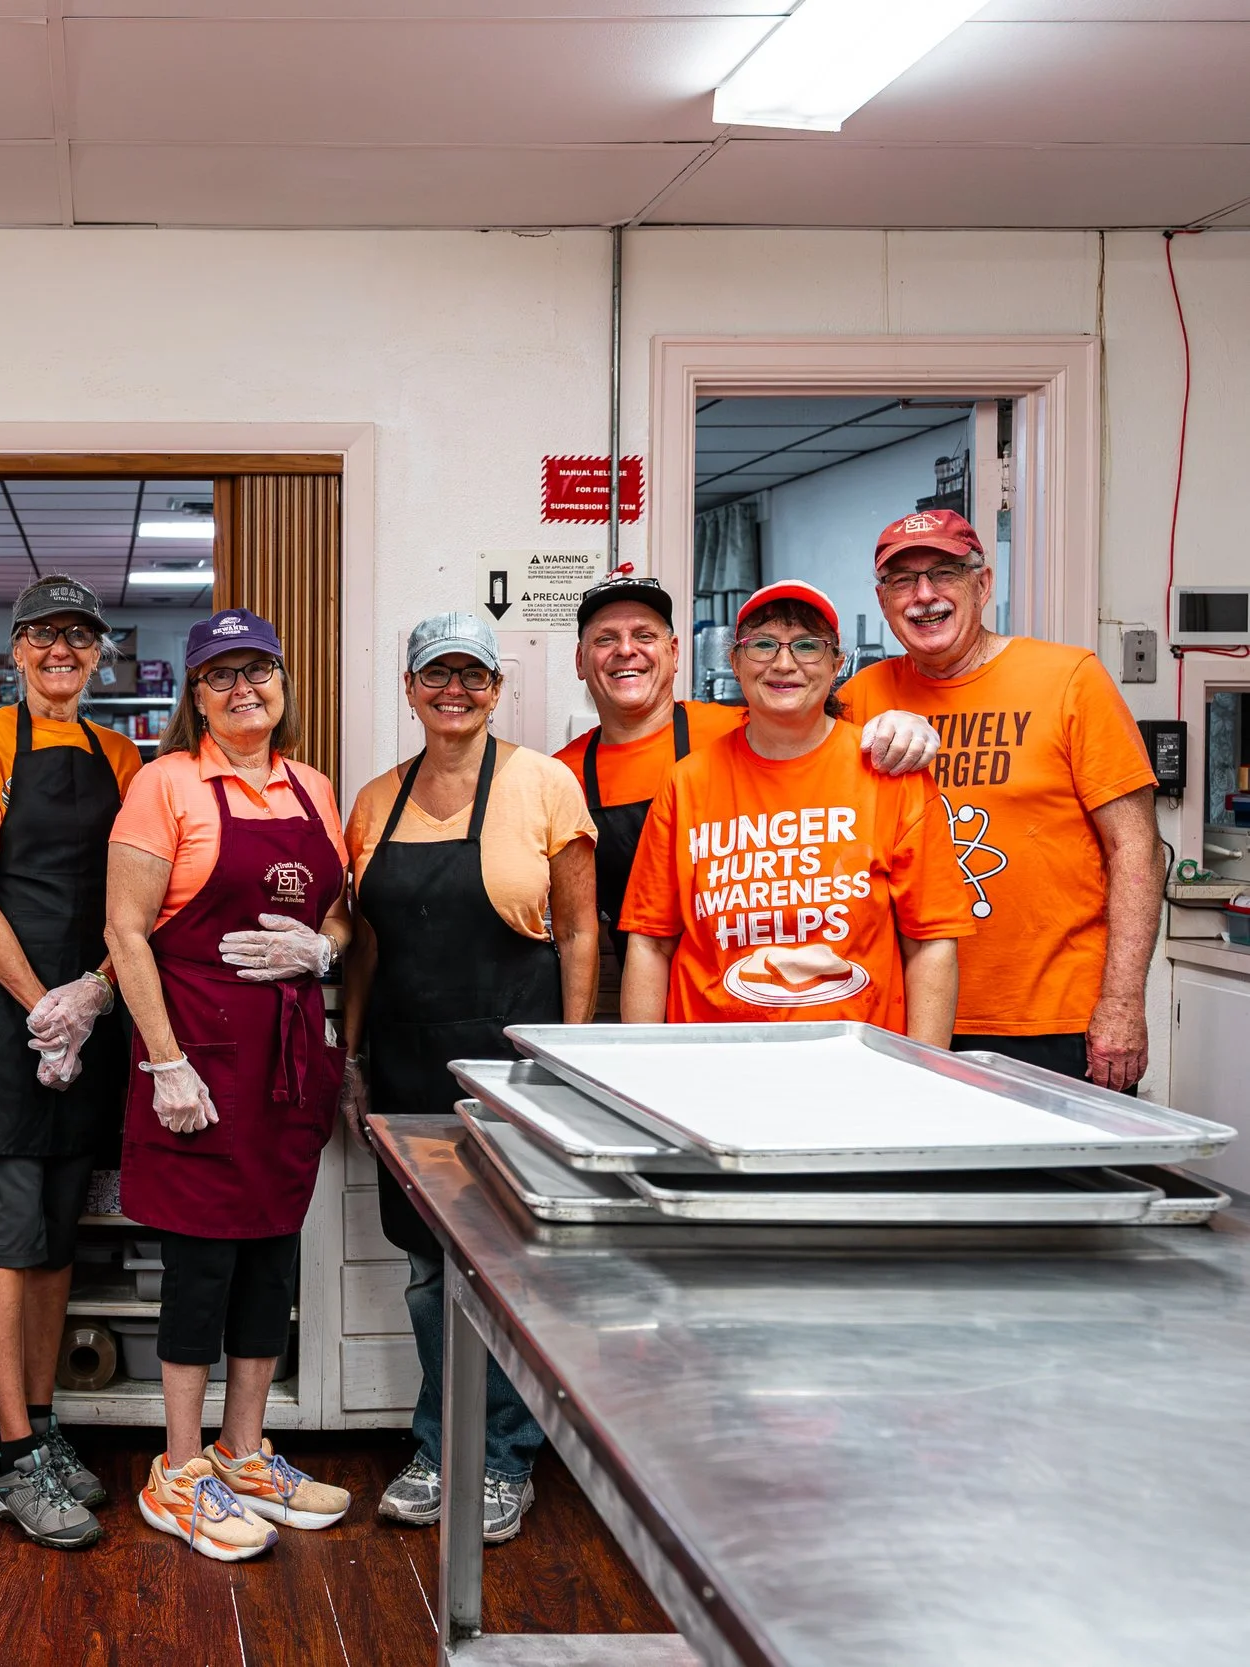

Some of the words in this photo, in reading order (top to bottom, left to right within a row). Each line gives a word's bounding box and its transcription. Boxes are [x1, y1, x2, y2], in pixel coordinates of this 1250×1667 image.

[593, 469, 627, 477] RELESE
[604, 503, 636, 511] STEM
[542, 555, 589, 563] WARNING
[533, 592, 582, 601] PRECAUCI
[927, 711, 1032, 749] TIVELY
[934, 750, 1011, 788] RGED
[688, 806, 857, 865] HUNGER
[278, 861, 294, 869] Truth
[707, 846, 821, 888] HURTS
[270, 895, 284, 903] Soup
[695, 870, 871, 922] AWARENESS
[715, 903, 850, 951] HELPS
